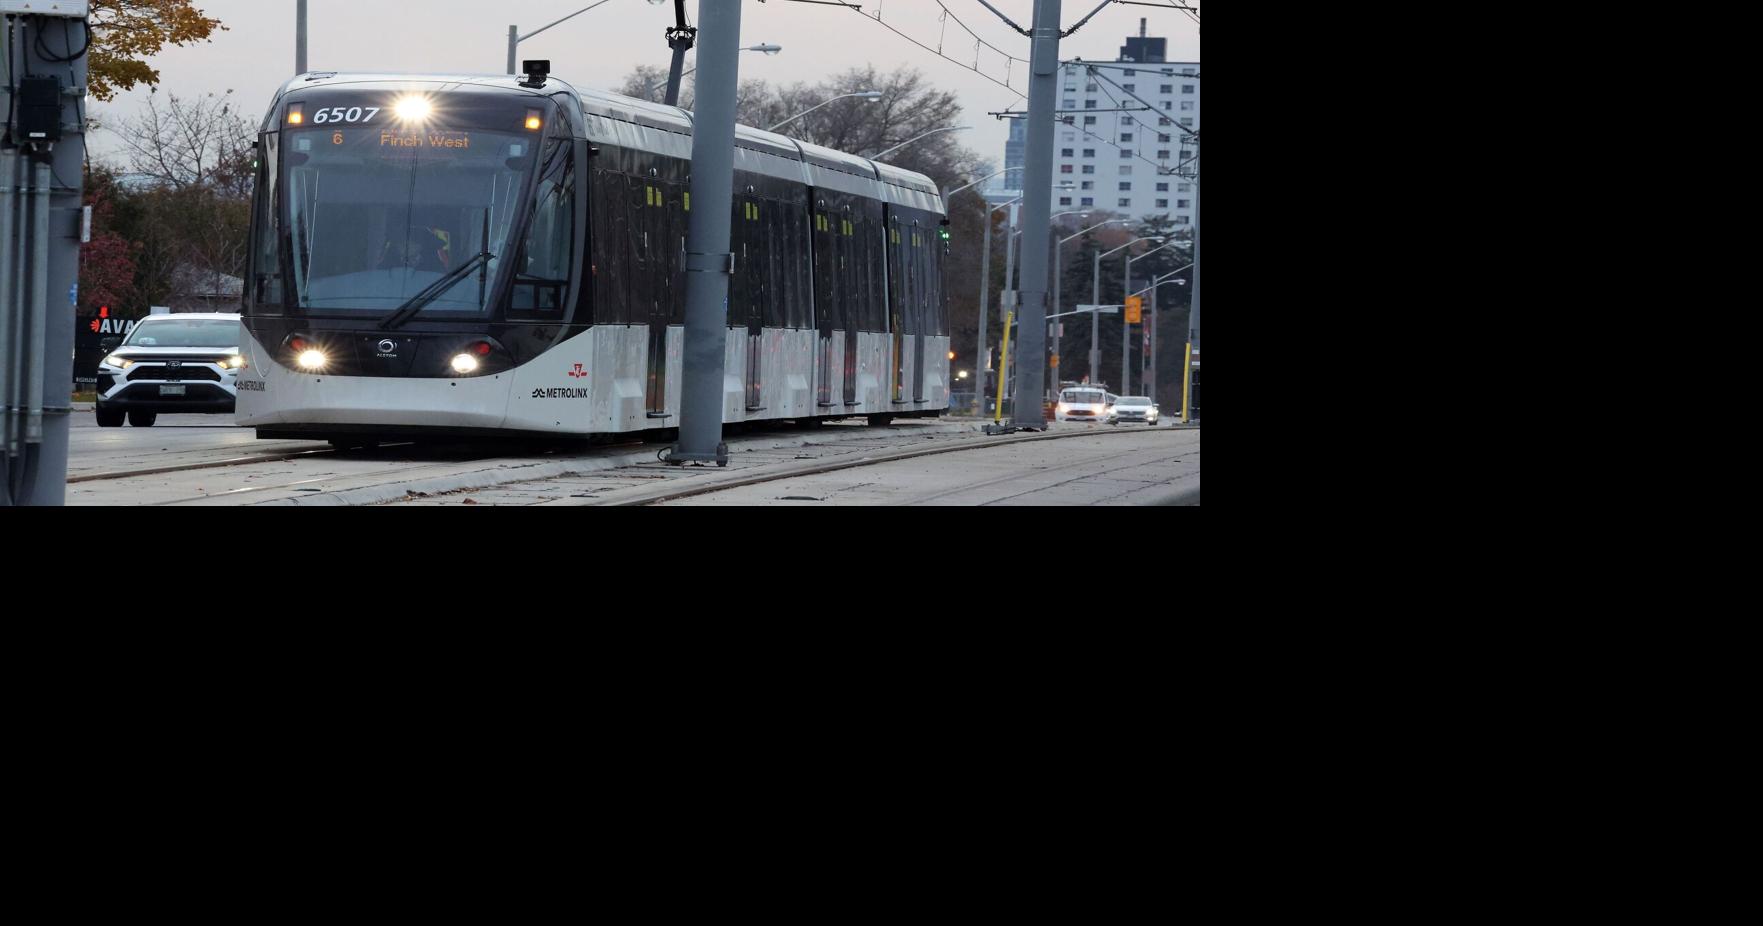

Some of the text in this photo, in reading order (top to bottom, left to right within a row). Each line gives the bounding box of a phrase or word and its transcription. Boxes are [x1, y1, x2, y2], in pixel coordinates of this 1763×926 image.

[313, 107, 380, 124] 6507
[332, 133, 470, 149] 6 Finch West
[99, 319, 141, 334] AVA
[546, 388, 588, 398] METROLINX
